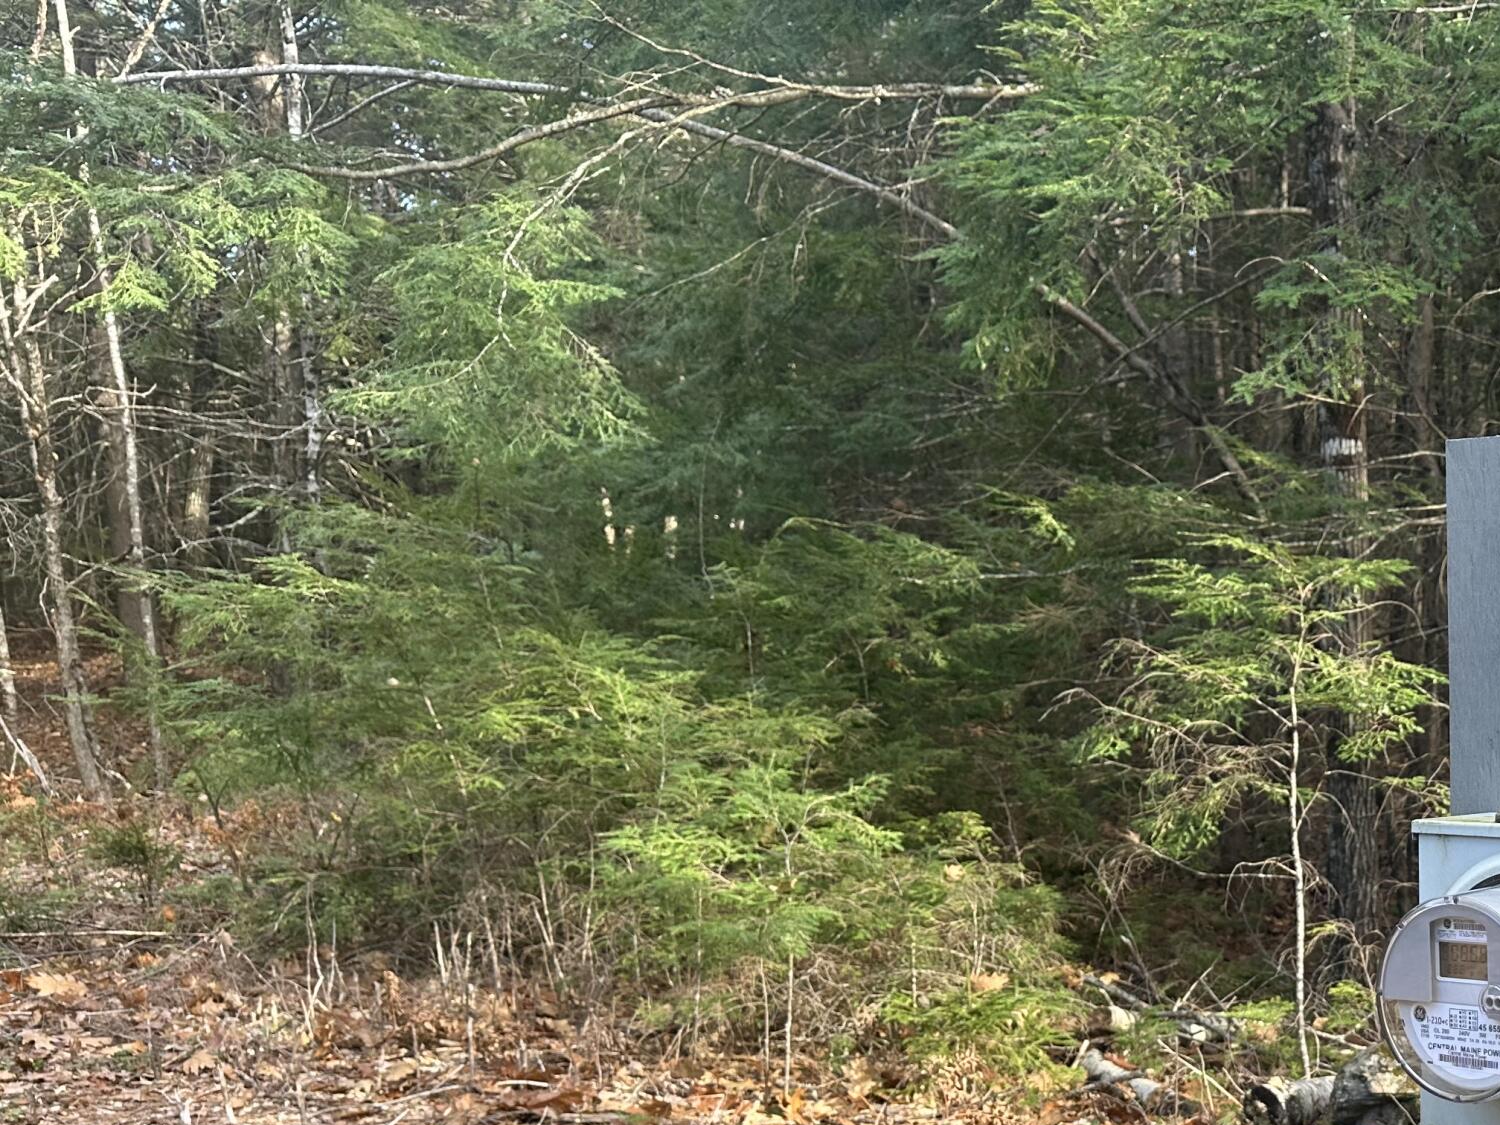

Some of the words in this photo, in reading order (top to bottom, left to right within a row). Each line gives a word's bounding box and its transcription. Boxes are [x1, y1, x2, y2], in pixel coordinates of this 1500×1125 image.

[1478, 1024, 1488, 1032] 45
[1427, 1042, 1457, 1052] CENTRAL
[1460, 1046, 1481, 1055] MAINE
